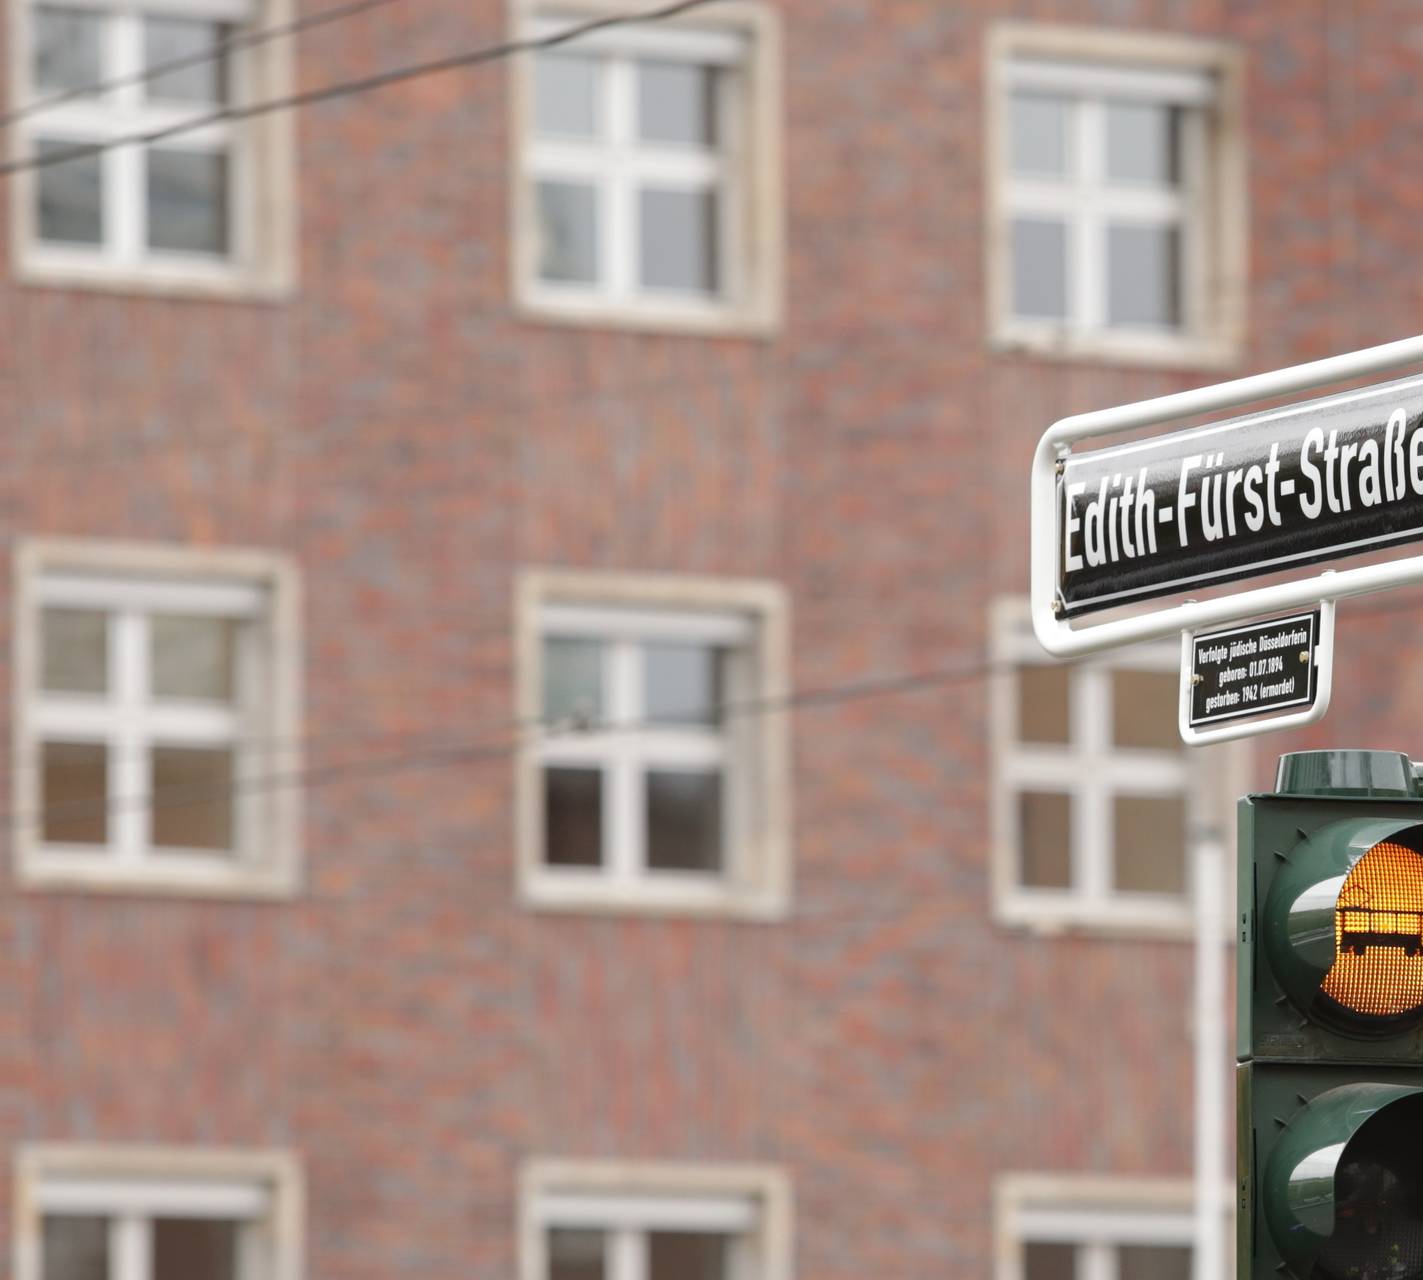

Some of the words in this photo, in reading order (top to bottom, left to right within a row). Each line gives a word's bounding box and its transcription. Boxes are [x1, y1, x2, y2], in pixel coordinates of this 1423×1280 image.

[1198, 645, 1228, 664] Verfolgte
[1229, 640, 1257, 662] jüdische
[1259, 629, 1306, 652] Düsseldorferin
[1218, 667, 1247, 687] geboren:
[1249, 656, 1283, 678] 01.07.1894
[1205, 690, 1240, 713] gestorben:
[1242, 684, 1258, 702] 1942
[1260, 676, 1295, 699] (ermordet)
